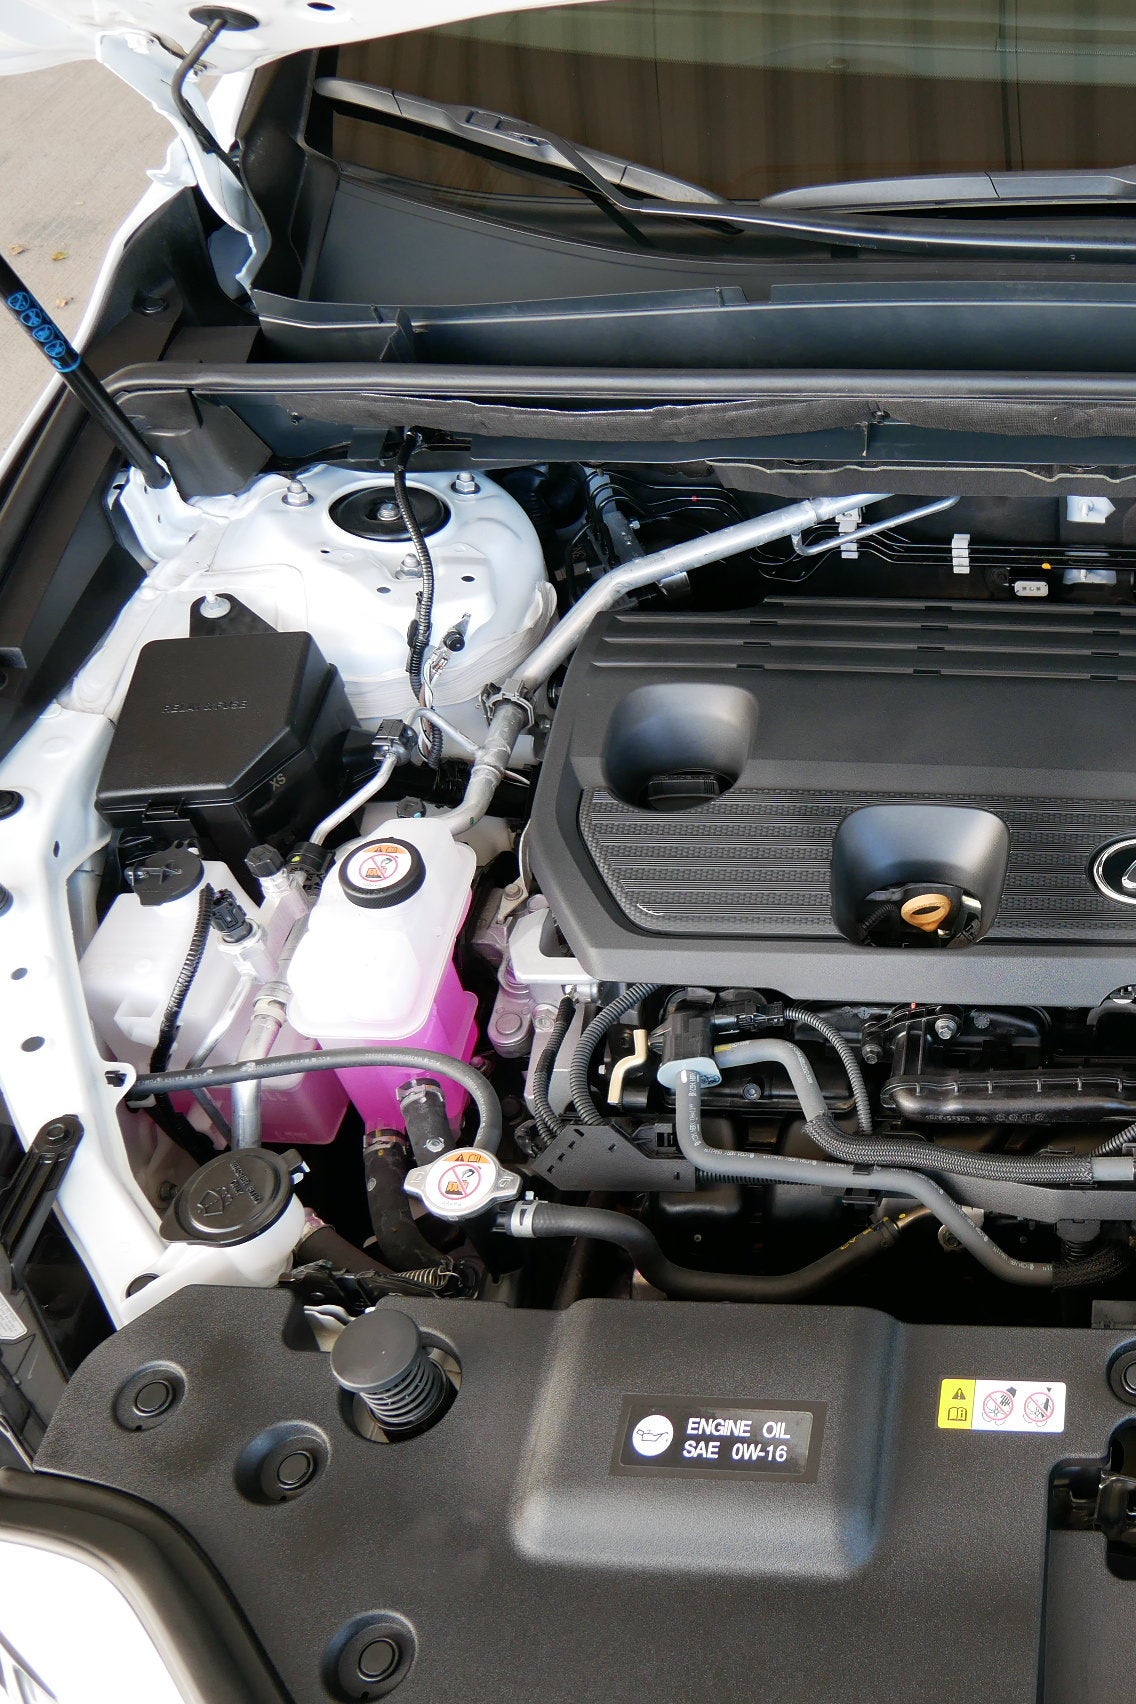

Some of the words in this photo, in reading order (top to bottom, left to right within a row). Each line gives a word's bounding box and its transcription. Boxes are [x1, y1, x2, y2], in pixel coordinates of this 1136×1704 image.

[686, 1417, 752, 1437] ENGINE
[761, 1420, 791, 1440] OIL
[682, 1439, 721, 1460] SAE
[731, 1442, 788, 1463] 0W-16
